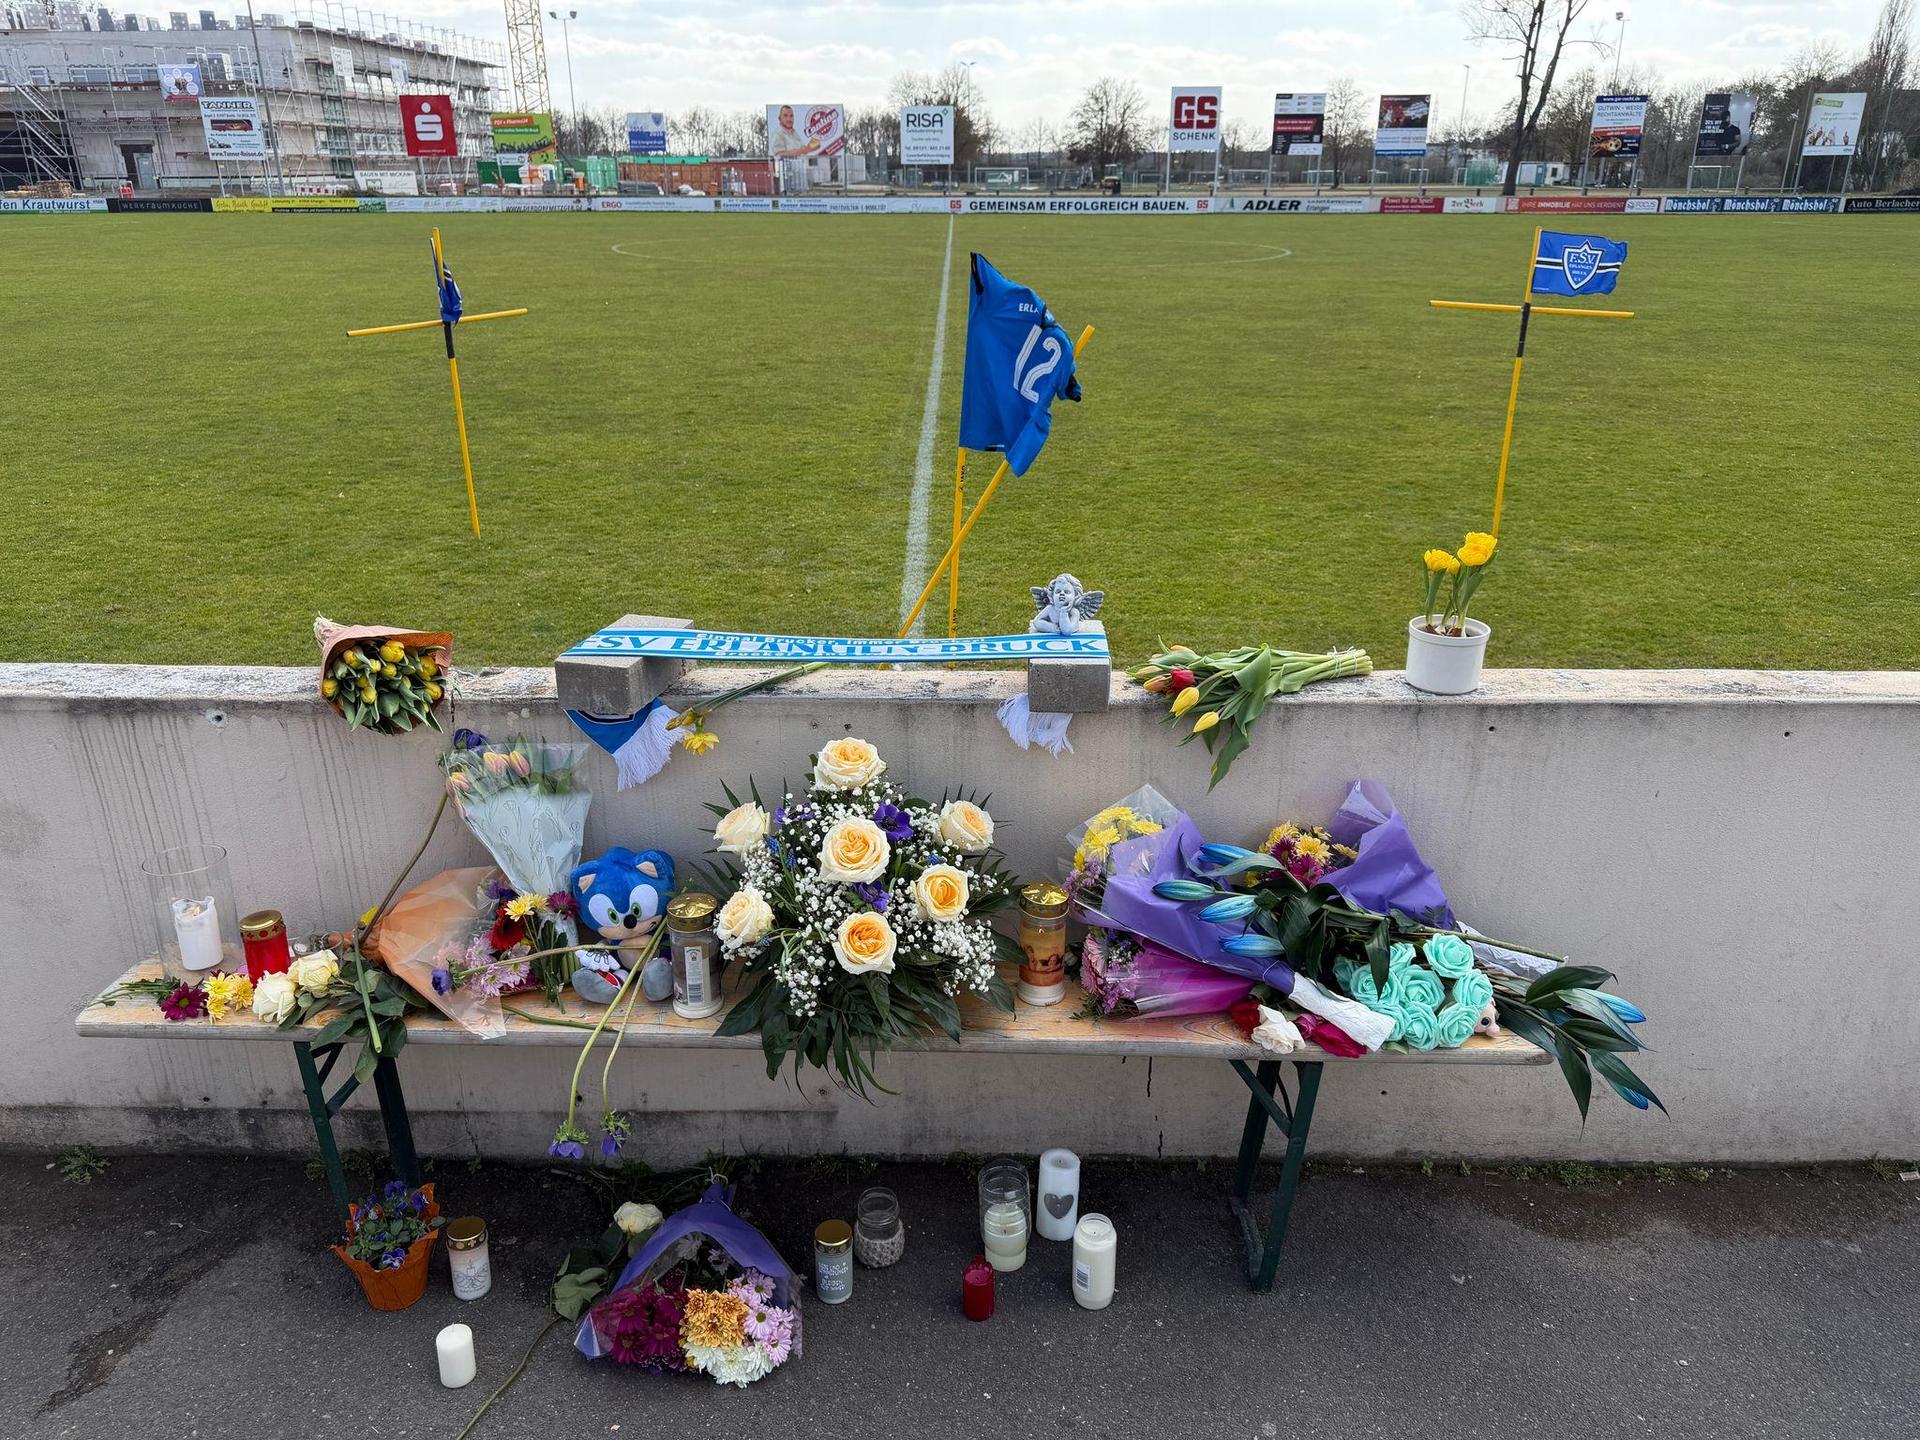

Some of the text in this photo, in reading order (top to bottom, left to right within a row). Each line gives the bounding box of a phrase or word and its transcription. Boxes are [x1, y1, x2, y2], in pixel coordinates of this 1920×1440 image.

[201, 101, 254, 109] TANNER
[1174, 96, 1217, 129] GS
[906, 113, 943, 127] RISA
[1172, 132, 1216, 141] SCHENK
[23, 200, 90, 210] Krautwurst
[601, 201, 622, 209] ERGO
[950, 200, 962, 209] GS
[969, 201, 1189, 211] GEMEINSAM ERFOLGREICH BAUEN.
[1197, 200, 1209, 209] GS
[1243, 200, 1302, 211] ADLER
[1665, 199, 1710, 211] Mönchshof
[1724, 199, 1769, 211] Mönchshof
[1782, 199, 1827, 211] Mönchshof
[1848, 200, 1872, 208] Auto
[1013, 324, 1062, 404] 12
